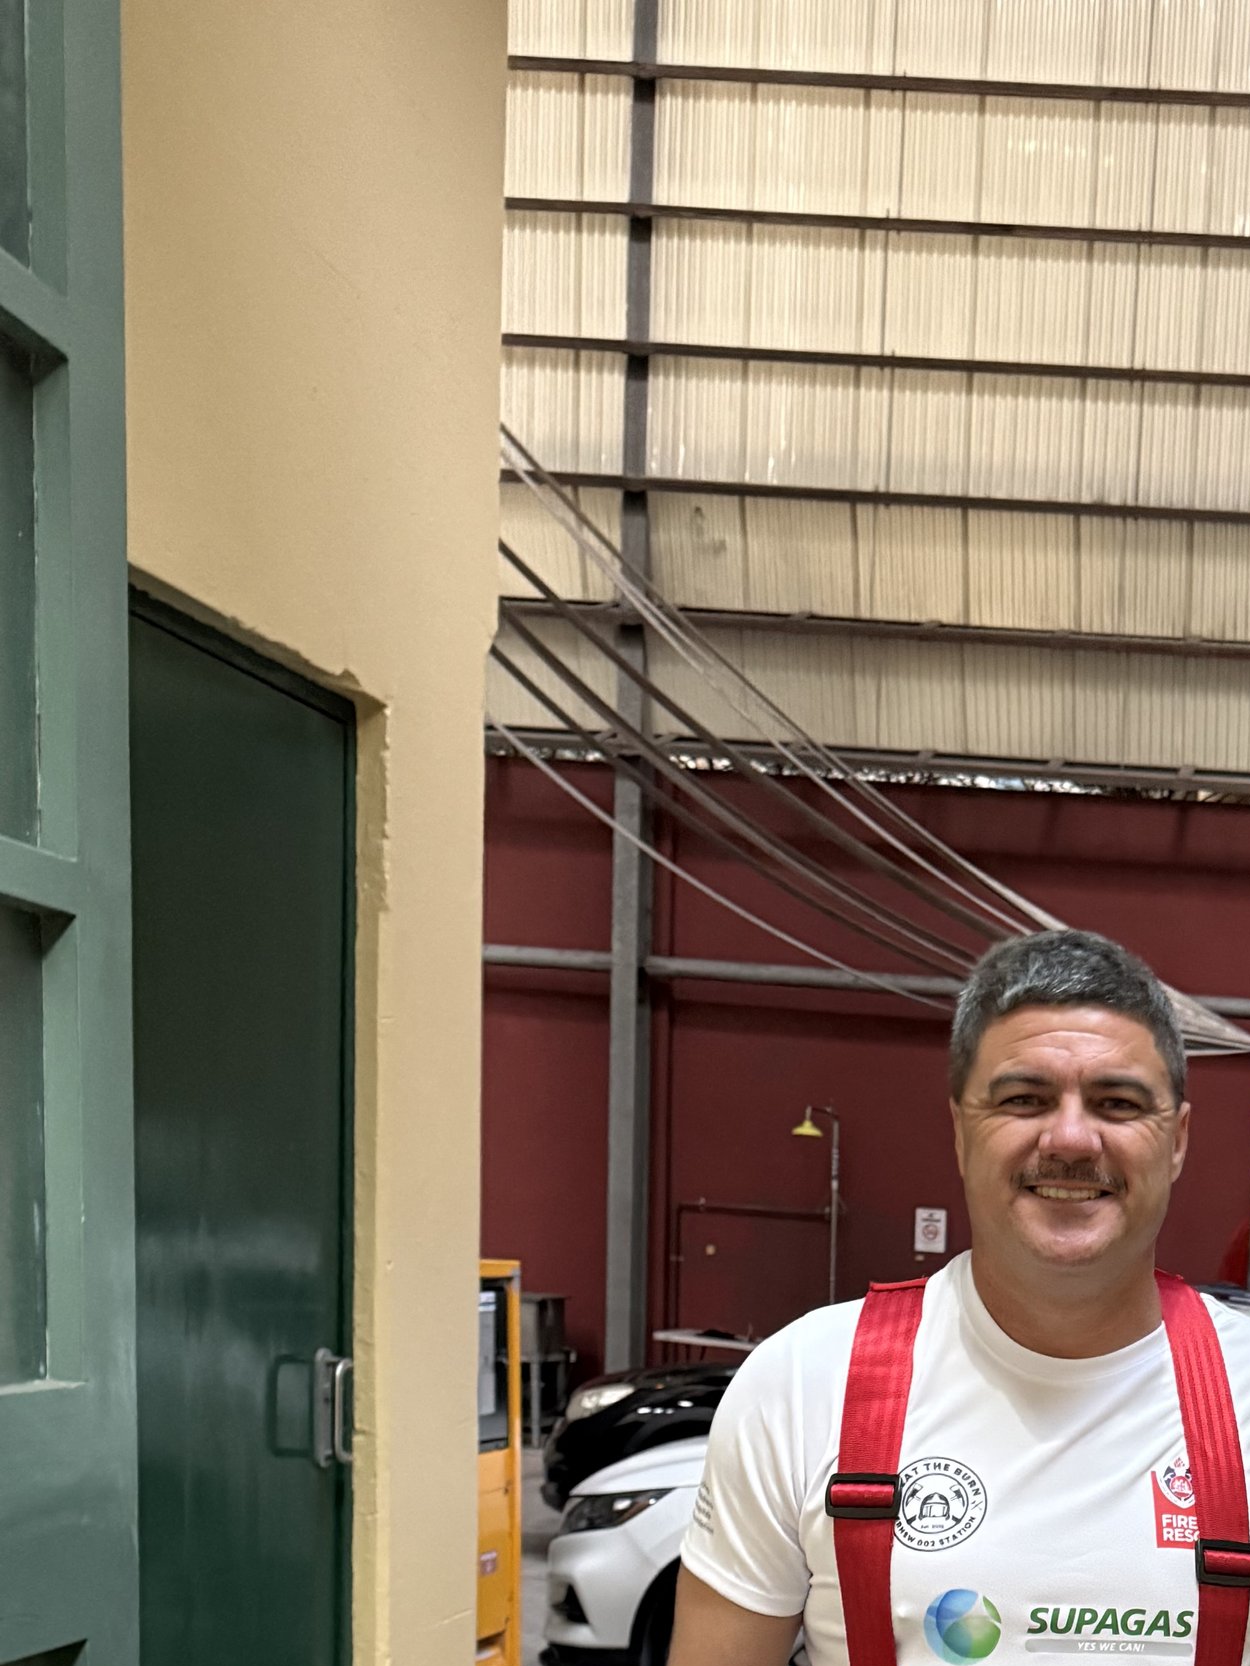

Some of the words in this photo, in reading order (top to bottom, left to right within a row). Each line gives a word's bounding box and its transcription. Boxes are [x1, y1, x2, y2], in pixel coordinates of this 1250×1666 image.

[923, 1462, 951, 1472] THE
[954, 1468, 981, 1497] BURN
[939, 1516, 976, 1546] STATION
[1162, 1513, 1199, 1530] FIRE
[1027, 1606, 1194, 1638] SUPAGAS
[1078, 1641, 1096, 1651] YES
[1099, 1642, 1115, 1652] WE
[1119, 1643, 1145, 1653] CAN!
